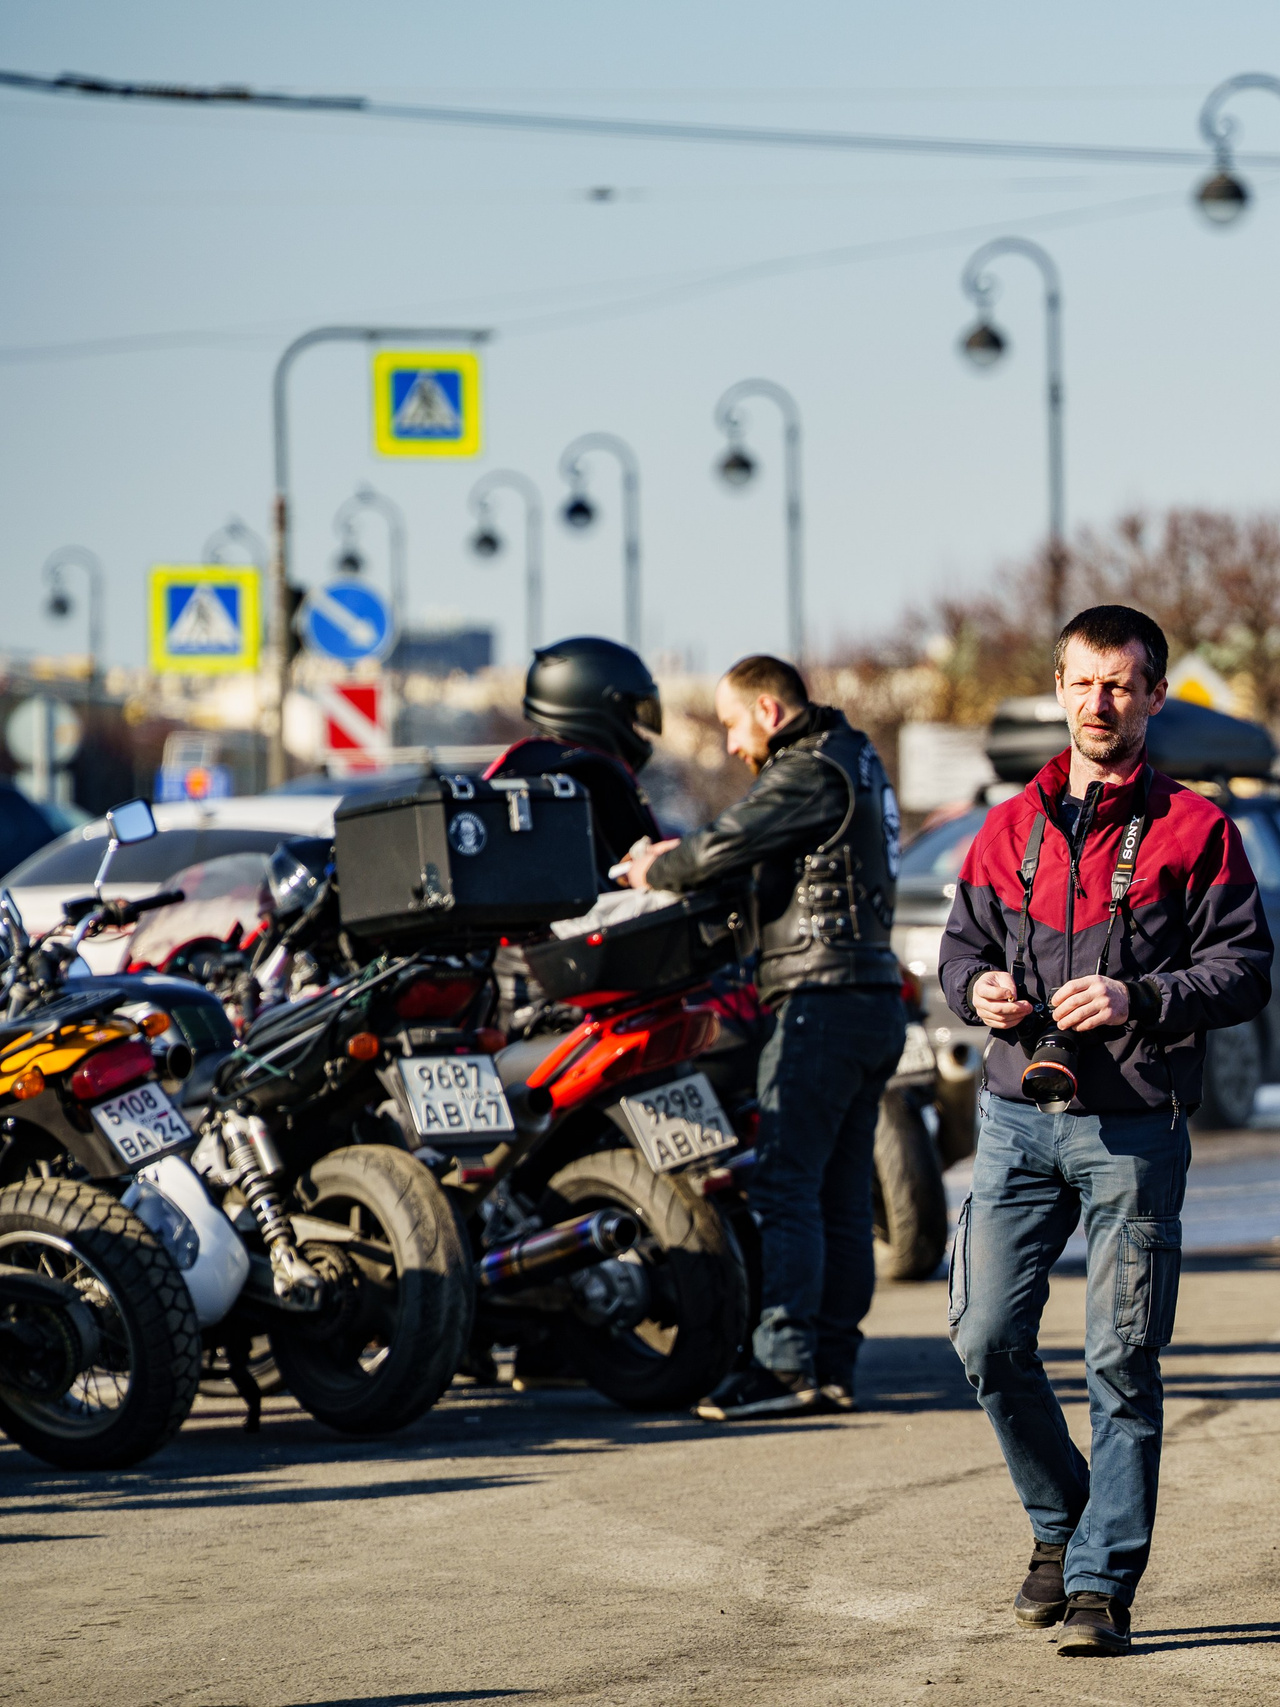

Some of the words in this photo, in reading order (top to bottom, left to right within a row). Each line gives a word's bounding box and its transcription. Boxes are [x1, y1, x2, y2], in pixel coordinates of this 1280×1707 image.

[1122, 815, 1140, 860] SONY
[415, 1063, 479, 1092] 9687
[101, 1089, 158, 1125] 5108
[422, 1101, 461, 1129] AB
[469, 1100, 499, 1127] 47
[640, 1084, 704, 1125] 9298
[119, 1131, 156, 1158] BA
[153, 1116, 184, 1143] 24
[652, 1130, 692, 1165] AB
